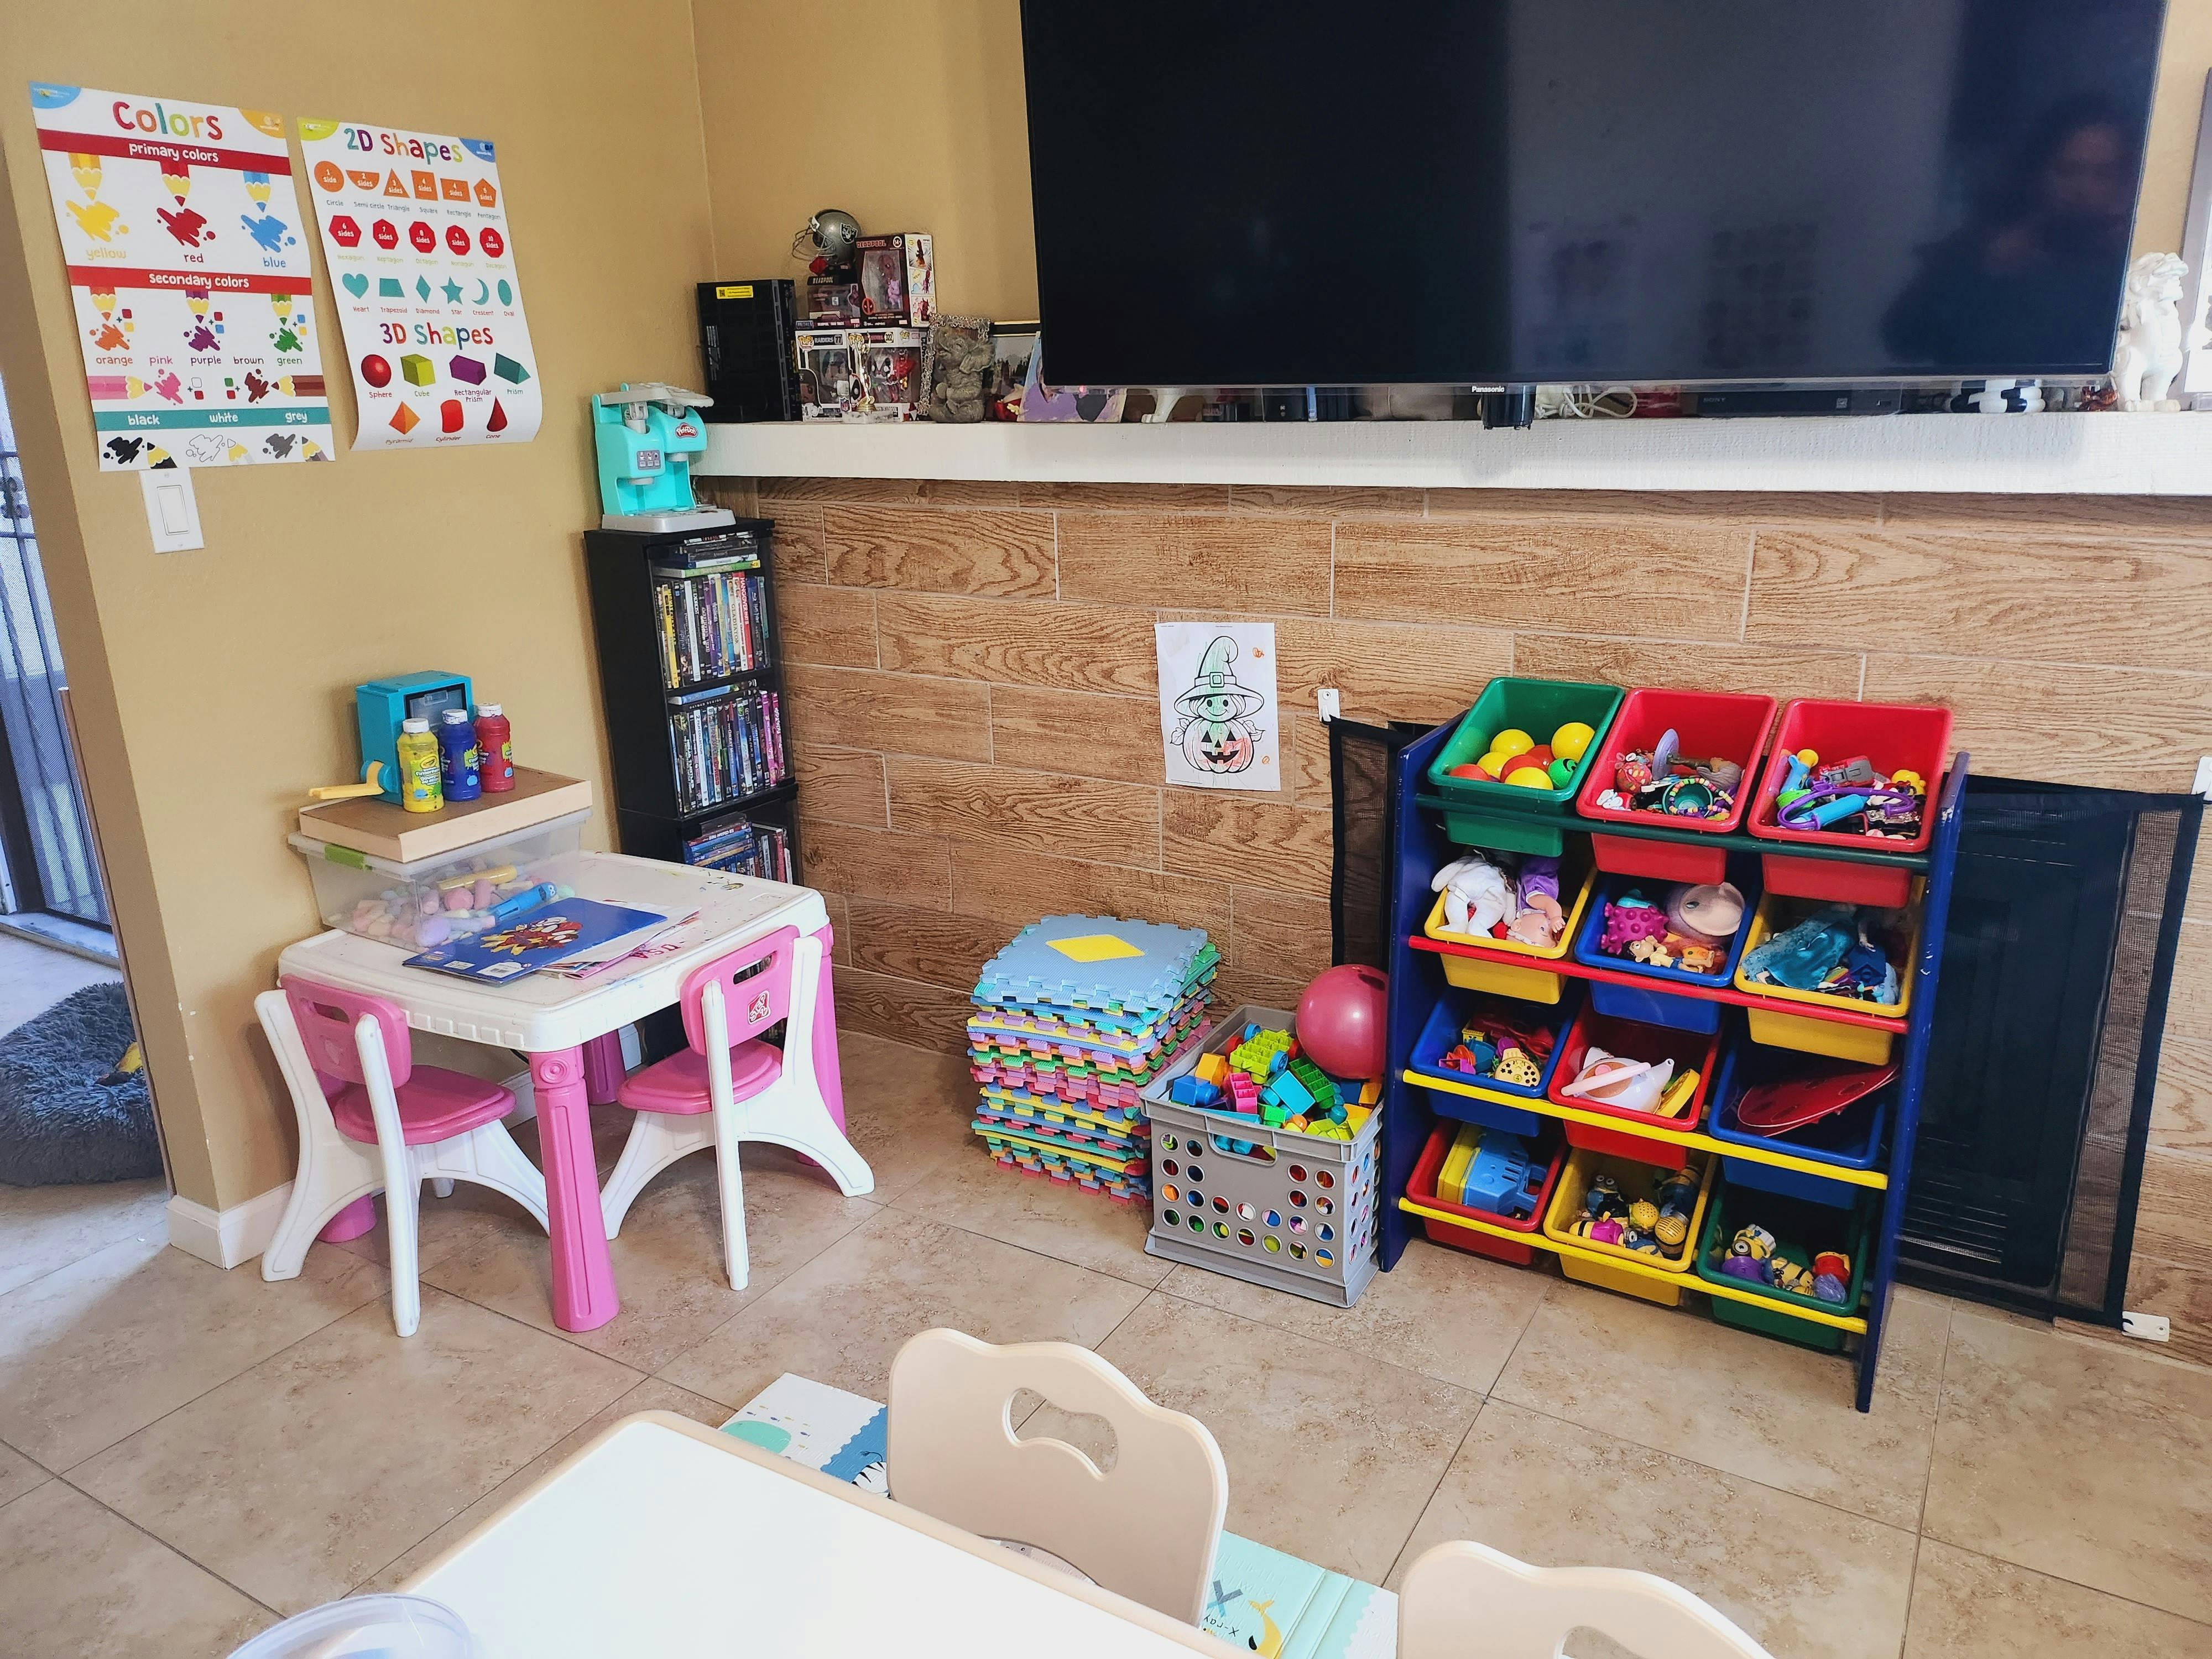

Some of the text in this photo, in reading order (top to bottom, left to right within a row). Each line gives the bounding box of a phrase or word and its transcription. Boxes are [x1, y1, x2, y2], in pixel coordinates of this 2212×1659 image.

[112, 101, 223, 140] Colors
[129, 143, 218, 162] primary colors
[344, 128, 463, 165] 2D Shapes
[387, 204, 410, 212] Triangle
[86, 247, 286, 268] yellow red blue
[215, 276, 249, 288] colors
[379, 322, 493, 350] 3D Shapes
[96, 355, 302, 367] orange pink purple brown green
[128, 411, 307, 425] black white grey
[1203, 1614, 1240, 1637] X-ray
